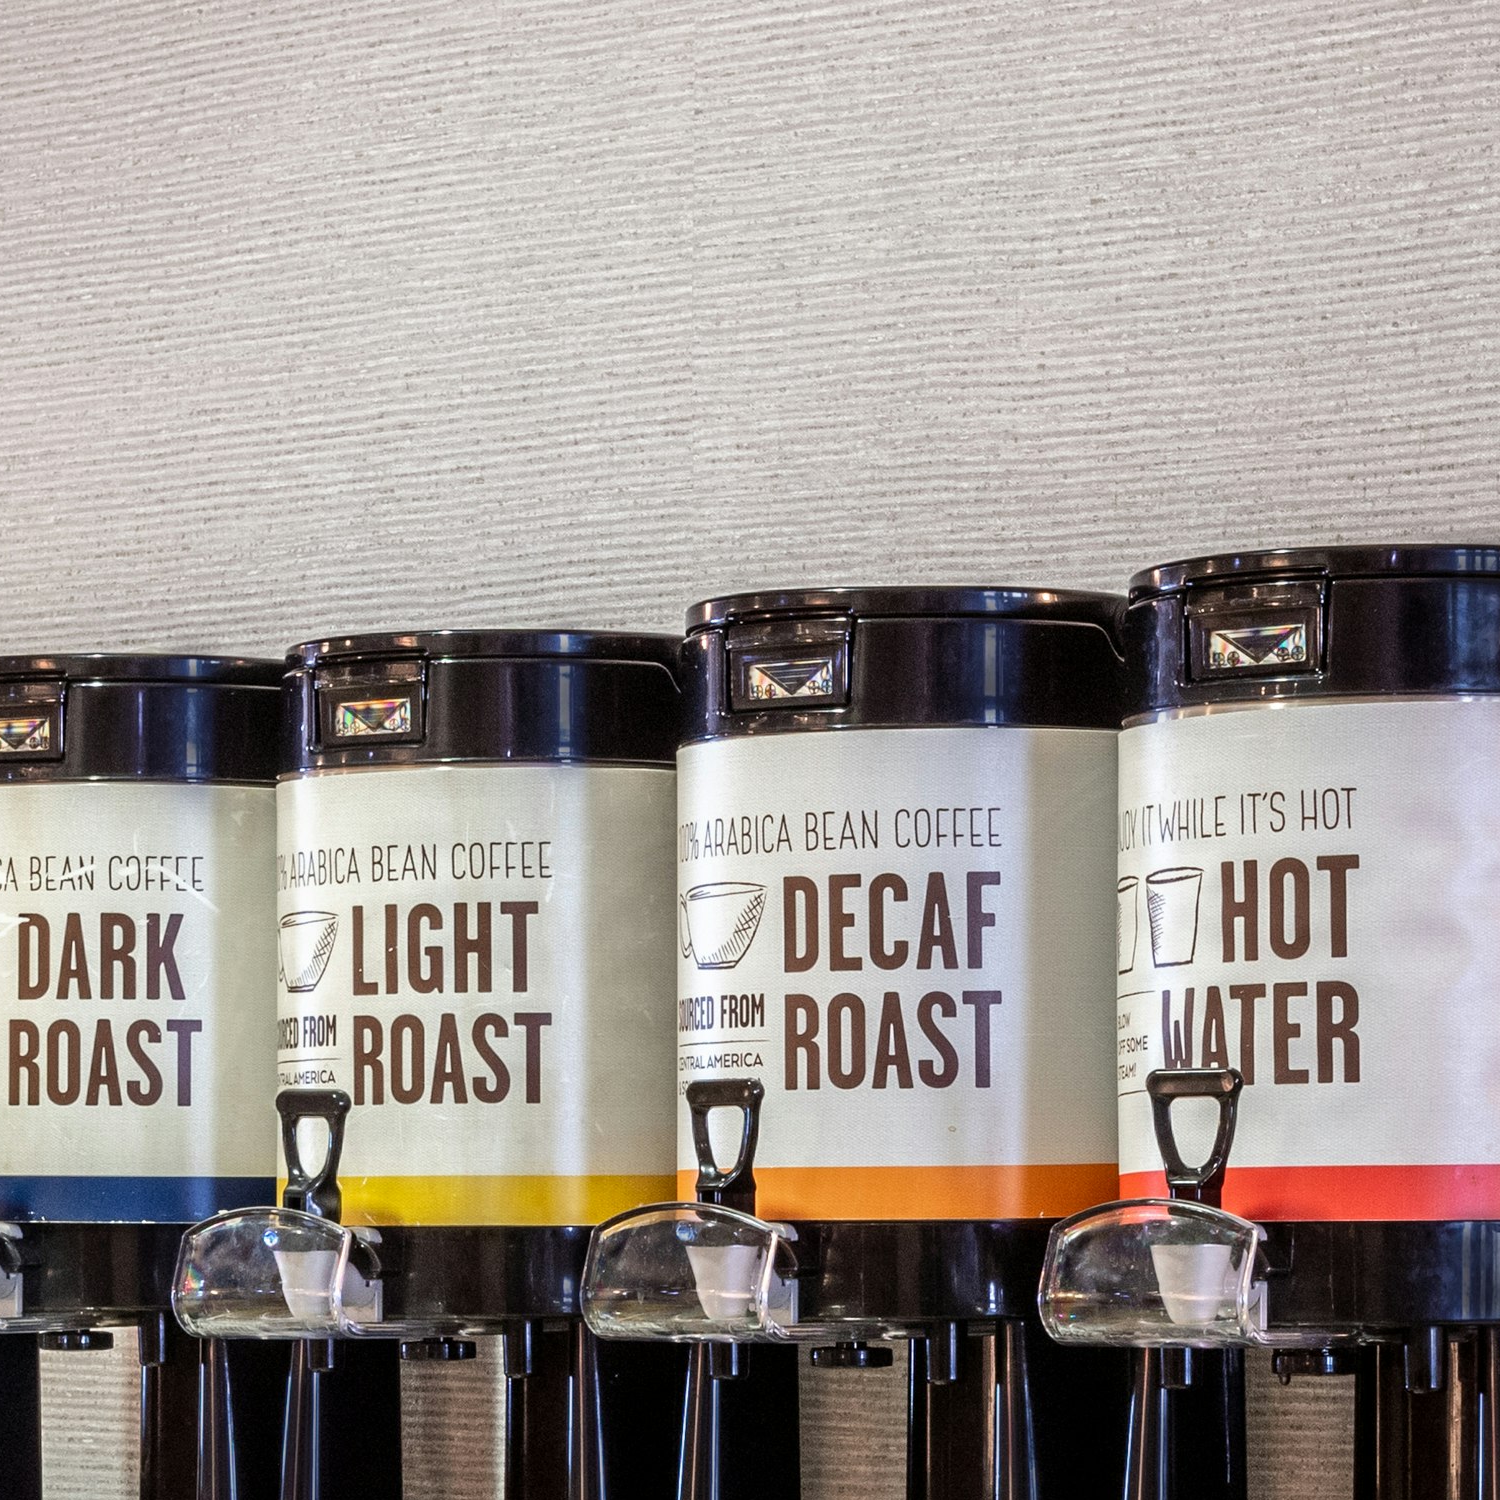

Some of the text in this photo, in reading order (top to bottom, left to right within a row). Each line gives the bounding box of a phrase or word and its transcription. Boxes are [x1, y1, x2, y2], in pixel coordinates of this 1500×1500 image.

[703, 813, 792, 858] ARABICA
[805, 810, 878, 851] BEAN
[895, 808, 1002, 848] COFFEE
[1142, 805, 1154, 846] IT
[1159, 795, 1227, 843] WHILE
[1240, 791, 1286, 835] IT'S
[1301, 788, 1357, 832] HOT
[29, 856, 95, 891] BEAN
[108, 855, 205, 892] COFFEE
[289, 847, 360, 888] ARABICA
[372, 843, 437, 882] BEAN
[451, 841, 553, 879] COFFEE
[352, 901, 539, 996] LIGHT
[783, 871, 1001, 973] DECAF
[1221, 854, 1359, 963] HOT
[18, 912, 186, 1000] DARK
[303, 1014, 337, 1048] FROM
[720, 993, 765, 1029] FROM
[784, 990, 1002, 1091] ROAST
[1162, 981, 1361, 1086] WATER
[8, 1019, 203, 1106] ROAST
[353, 1012, 553, 1106] ROAST
[707, 1052, 763, 1069] AMERICA
